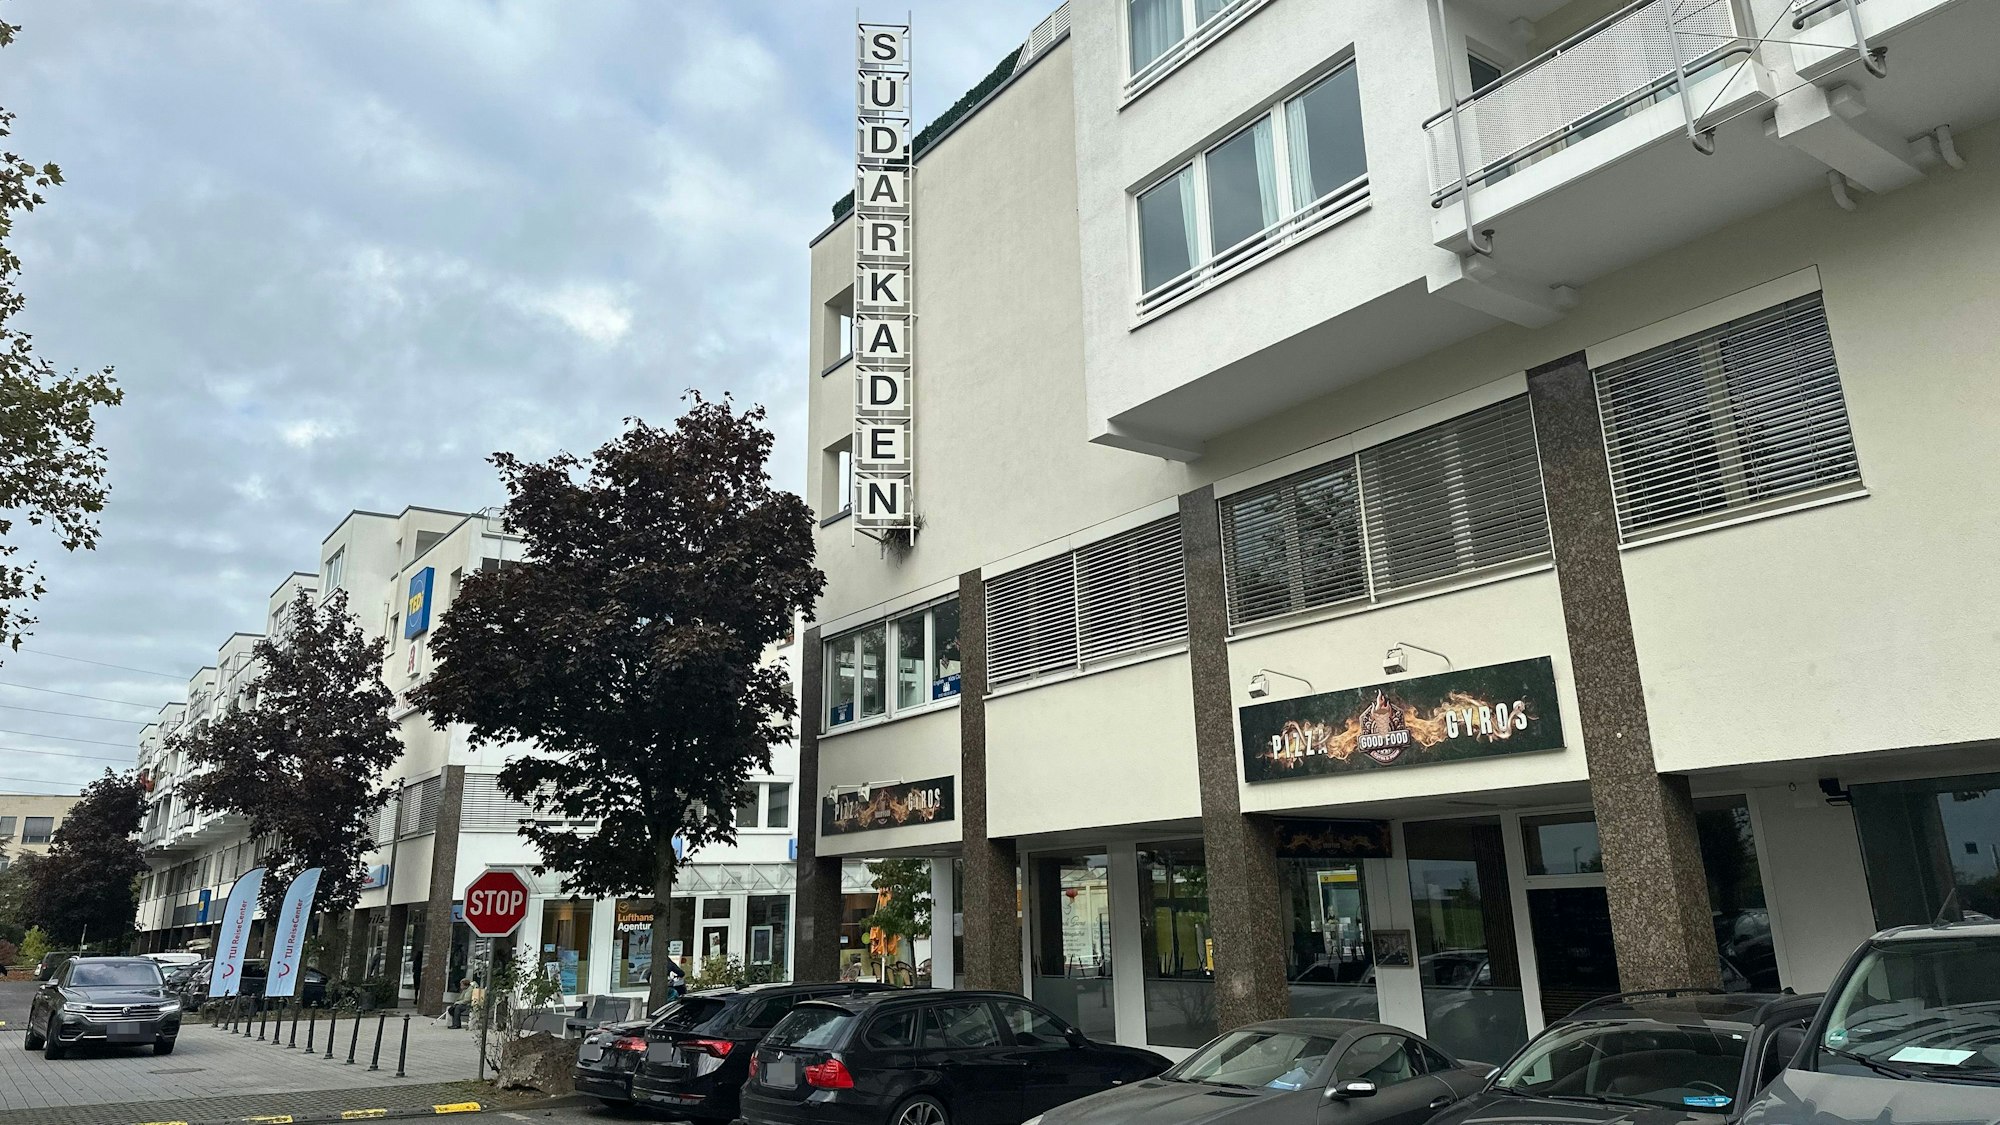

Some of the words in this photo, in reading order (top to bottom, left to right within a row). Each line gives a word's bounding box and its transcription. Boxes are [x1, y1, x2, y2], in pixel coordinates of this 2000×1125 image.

[869, 33, 899, 515] SÜDARKADEN
[1445, 700, 1528, 739] GYROS
[1272, 729, 1328, 760] PIZZA
[1361, 735, 1384, 749] GOOD
[1385, 732, 1408, 746] FOOD
[470, 889, 523, 916] STOP
[232, 900, 248, 945] ReiseCenter
[288, 899, 303, 944] ReiseCenter
[618, 913, 654, 922] Lufthans
[618, 922, 651, 932] Agentur
[229, 946, 238, 959] TUI
[285, 945, 294, 958] TUI
